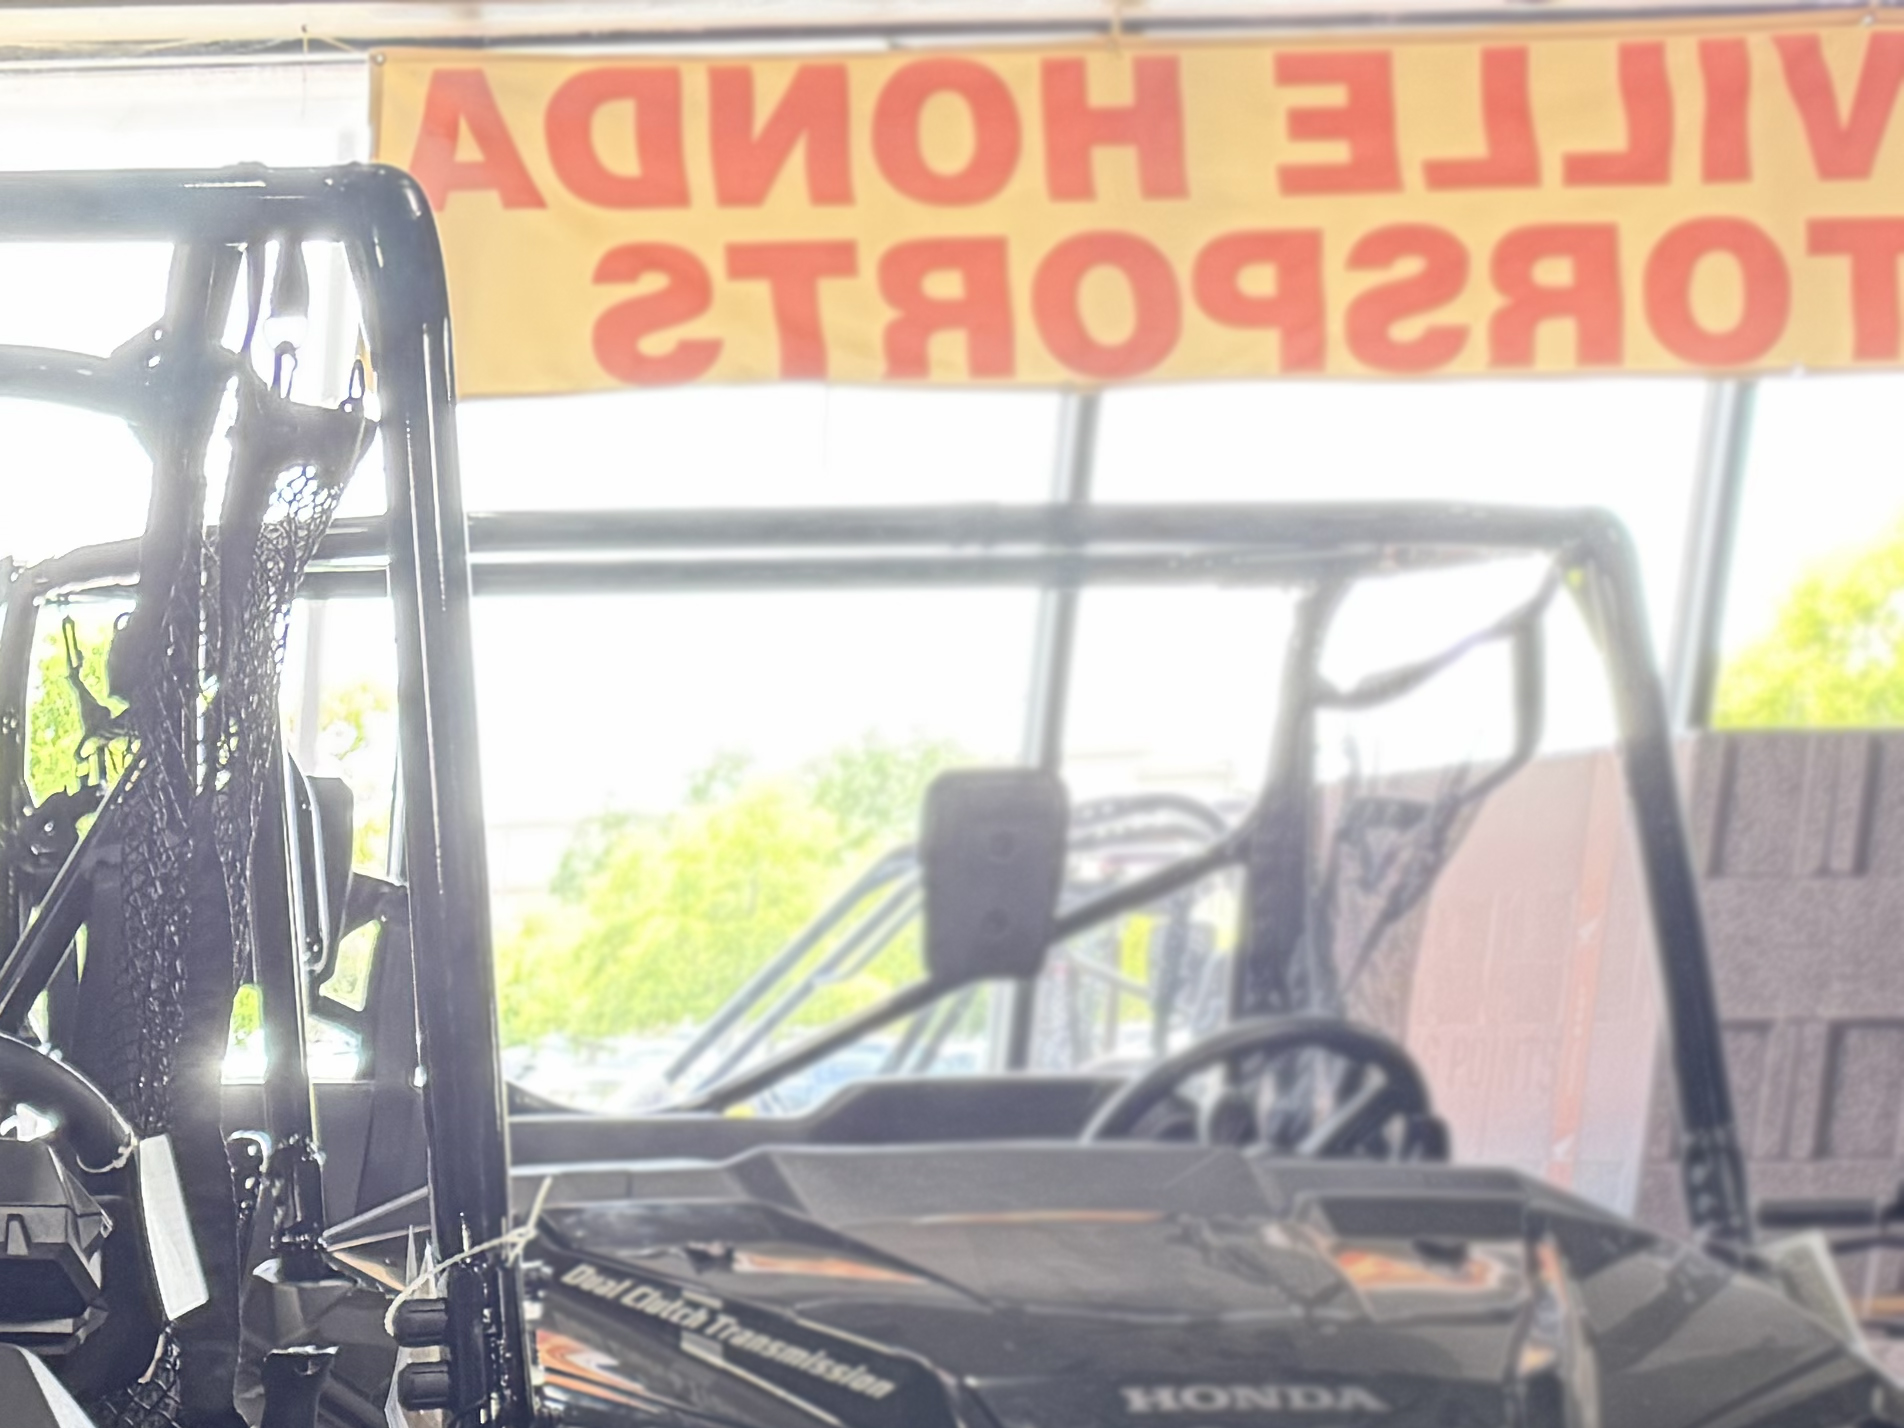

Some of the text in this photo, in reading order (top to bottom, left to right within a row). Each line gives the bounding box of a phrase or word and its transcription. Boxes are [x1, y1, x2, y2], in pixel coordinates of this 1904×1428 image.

[560, 1263, 896, 1400] Dual Clutch Transmission
[1120, 1383, 1391, 1413] HONDA
